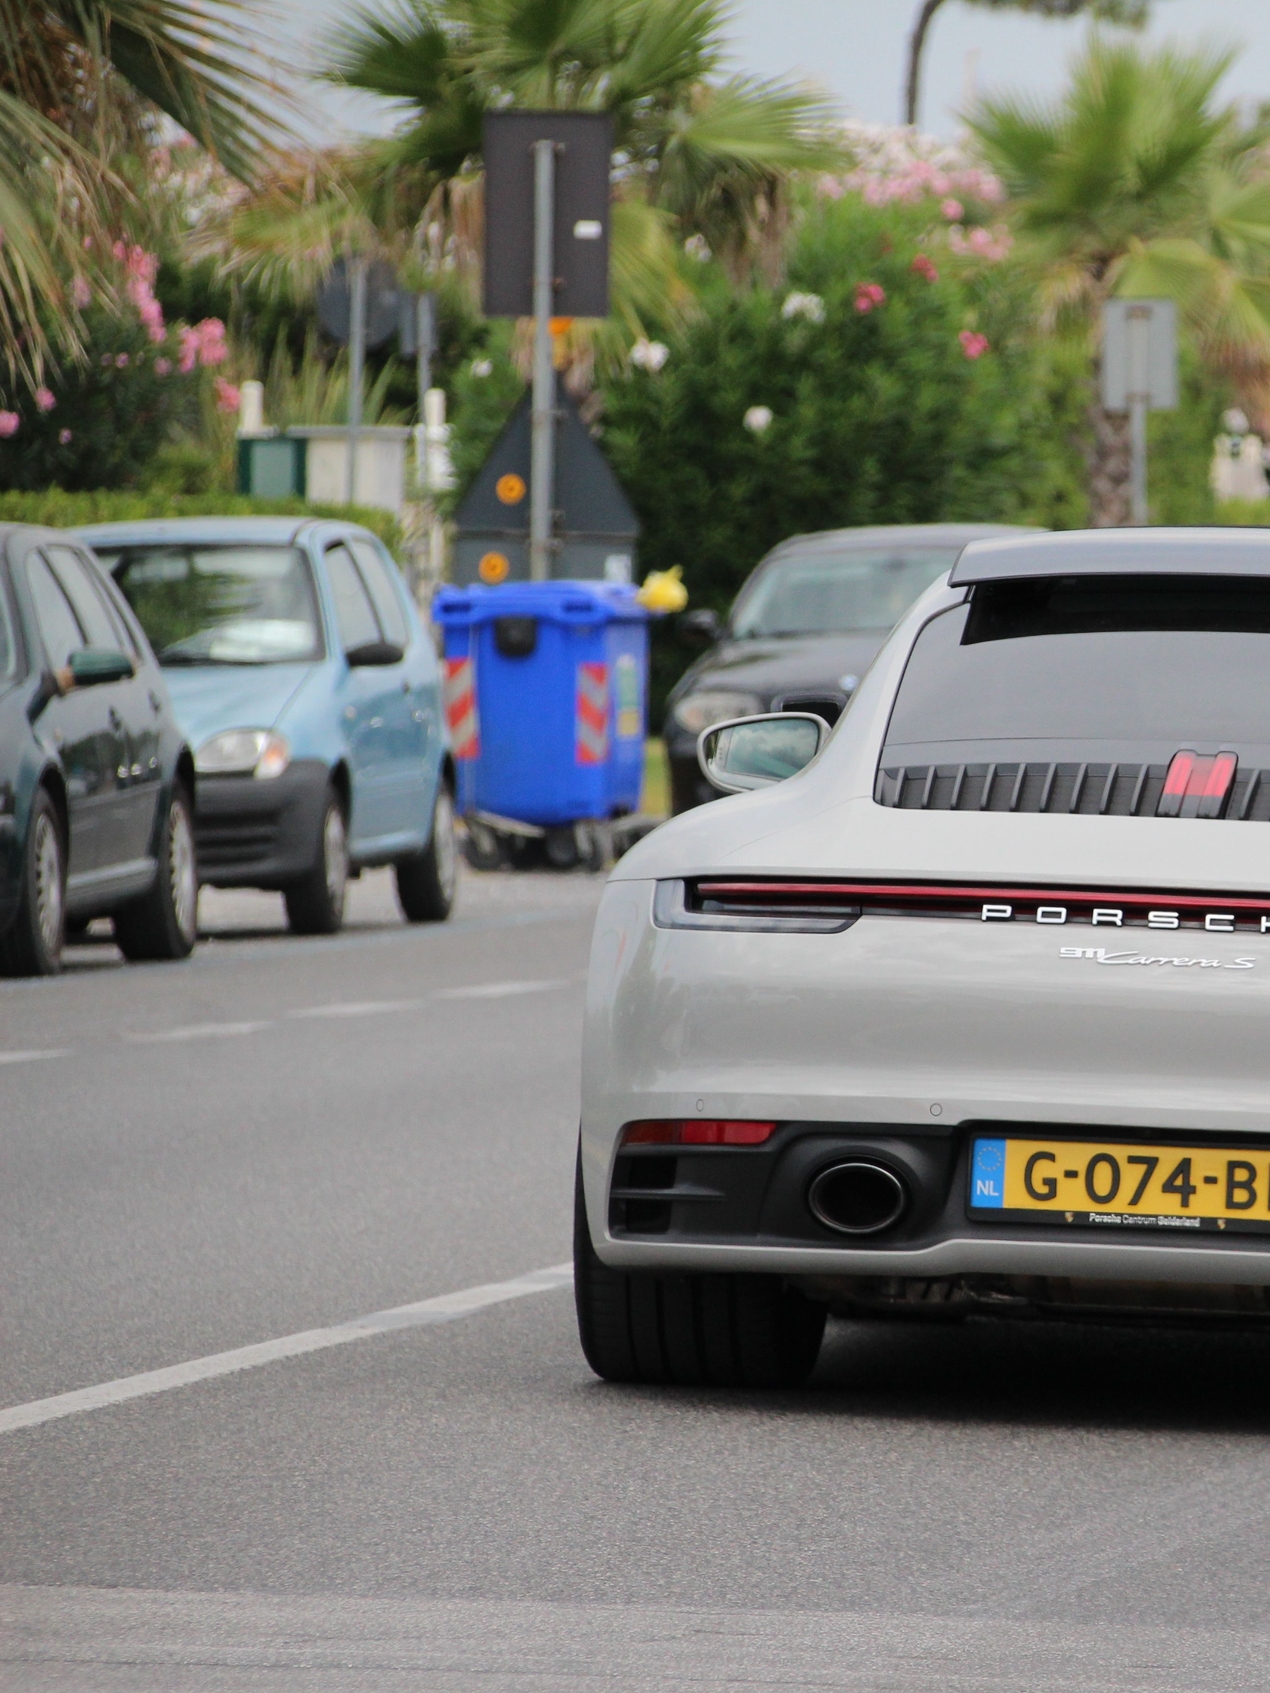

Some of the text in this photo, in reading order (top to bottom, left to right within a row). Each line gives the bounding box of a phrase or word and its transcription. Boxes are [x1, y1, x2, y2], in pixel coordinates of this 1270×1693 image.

[1059, 946, 1256, 969] 911 Carrera S
[976, 1179, 999, 1197] NL
[1089, 1212, 1121, 1224] Porsche
[1122, 1214, 1157, 1225] Centrum
